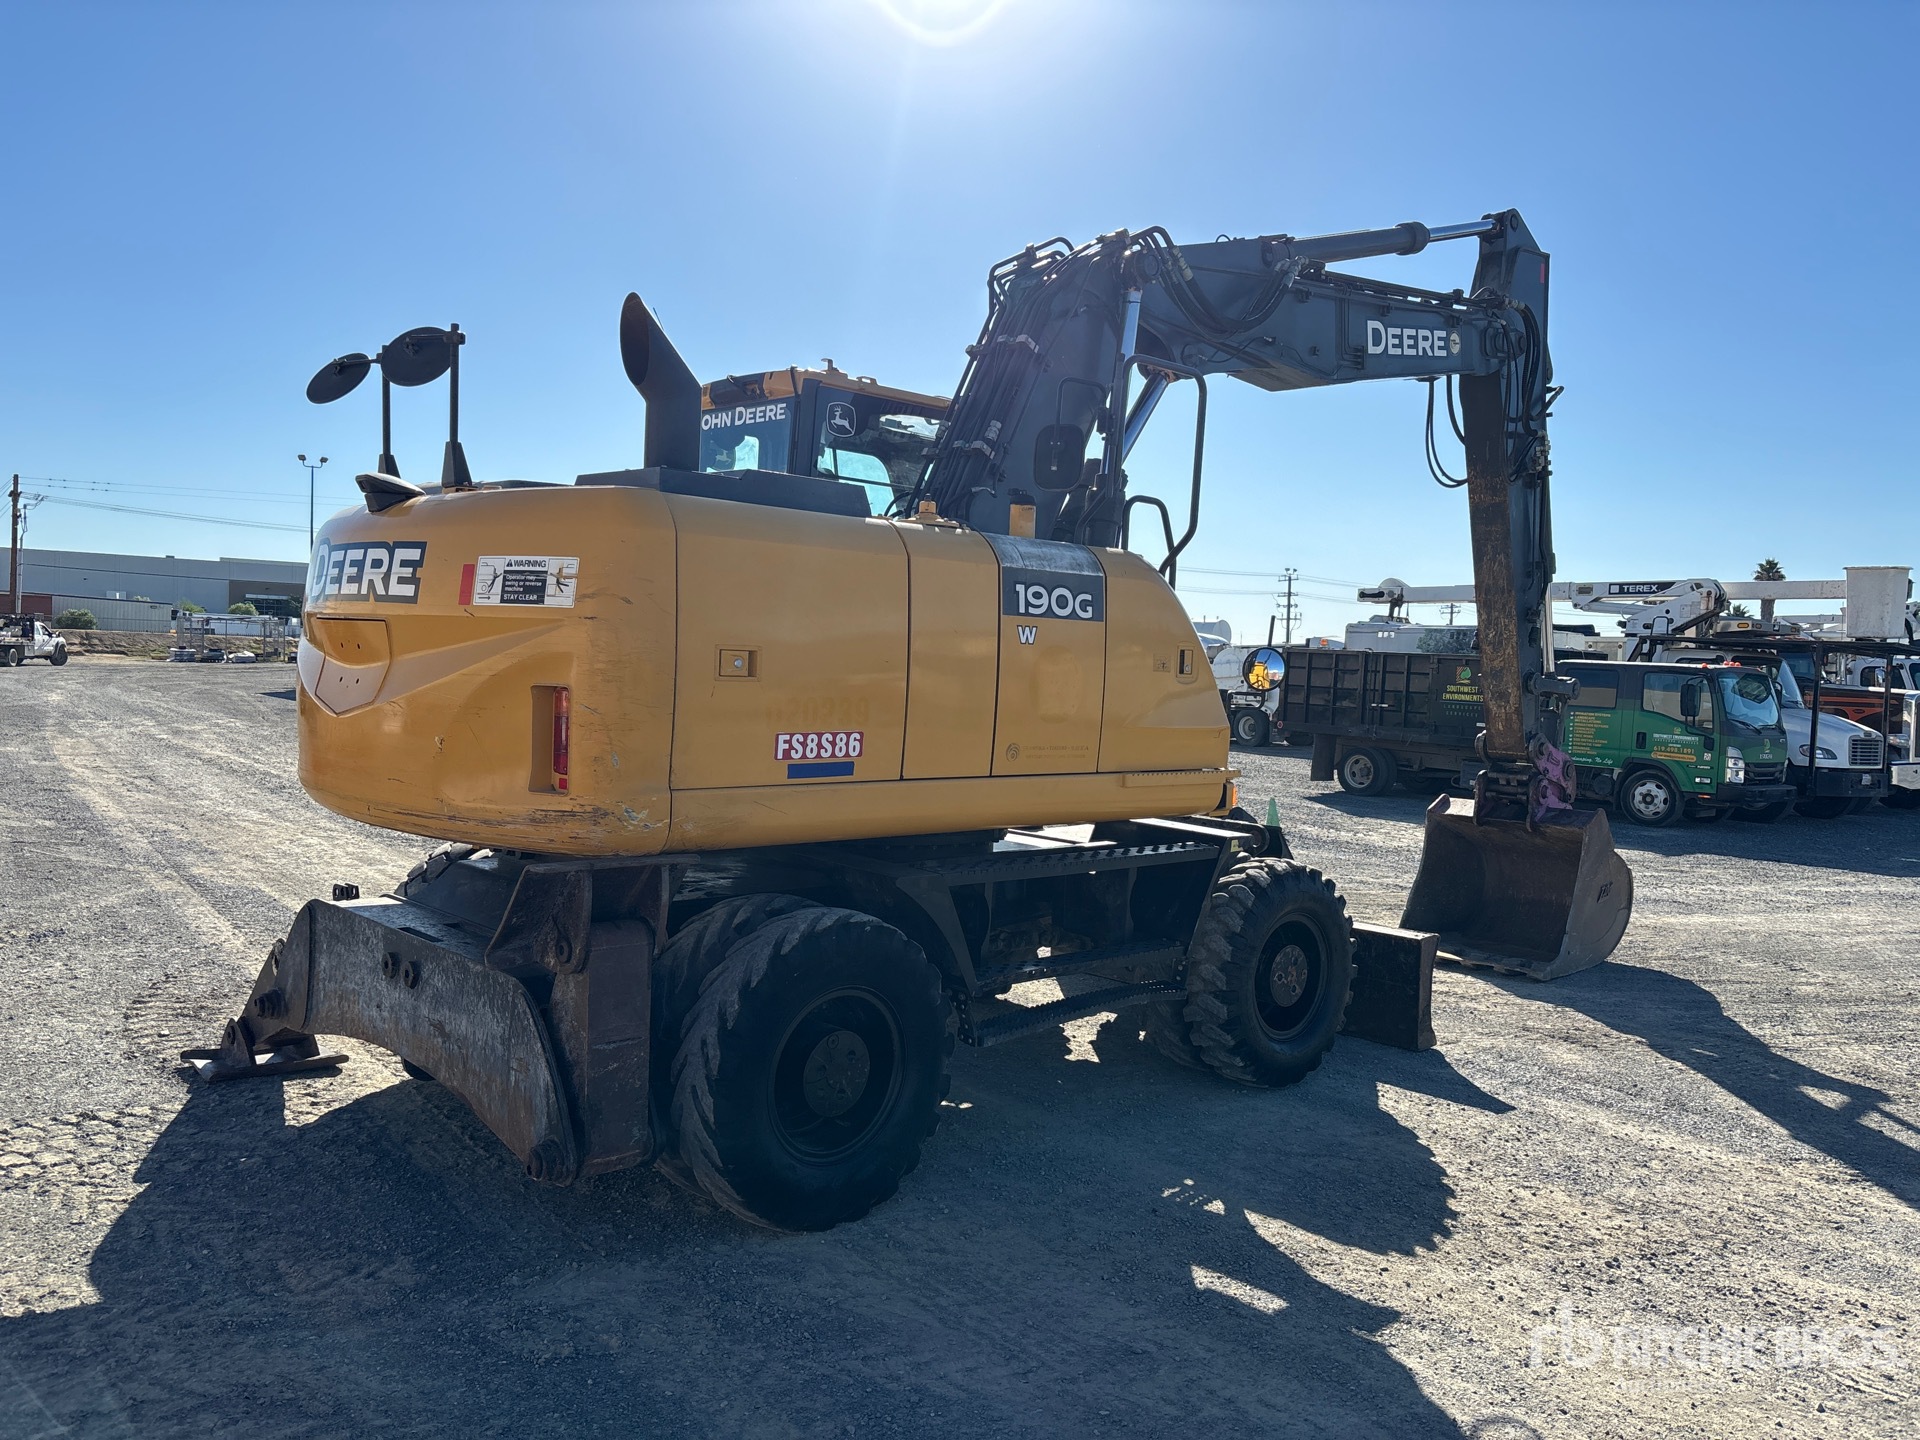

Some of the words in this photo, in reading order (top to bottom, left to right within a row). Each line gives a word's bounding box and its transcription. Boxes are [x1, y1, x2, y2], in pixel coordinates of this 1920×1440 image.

[1366, 319, 1447, 357] DEERE
[701, 411, 731, 431] OHN
[734, 403, 787, 425] DEERE
[313, 544, 422, 597] DEERE
[513, 559, 547, 568] WARNING
[1622, 584, 1659, 593] TEREX
[1015, 583, 1093, 619] 190G
[1018, 625, 1037, 644] W
[1442, 693, 1484, 702] ENVIRONMENTS
[1446, 685, 1478, 693] SOUTHWEST
[777, 732, 861, 759] FS8S86
